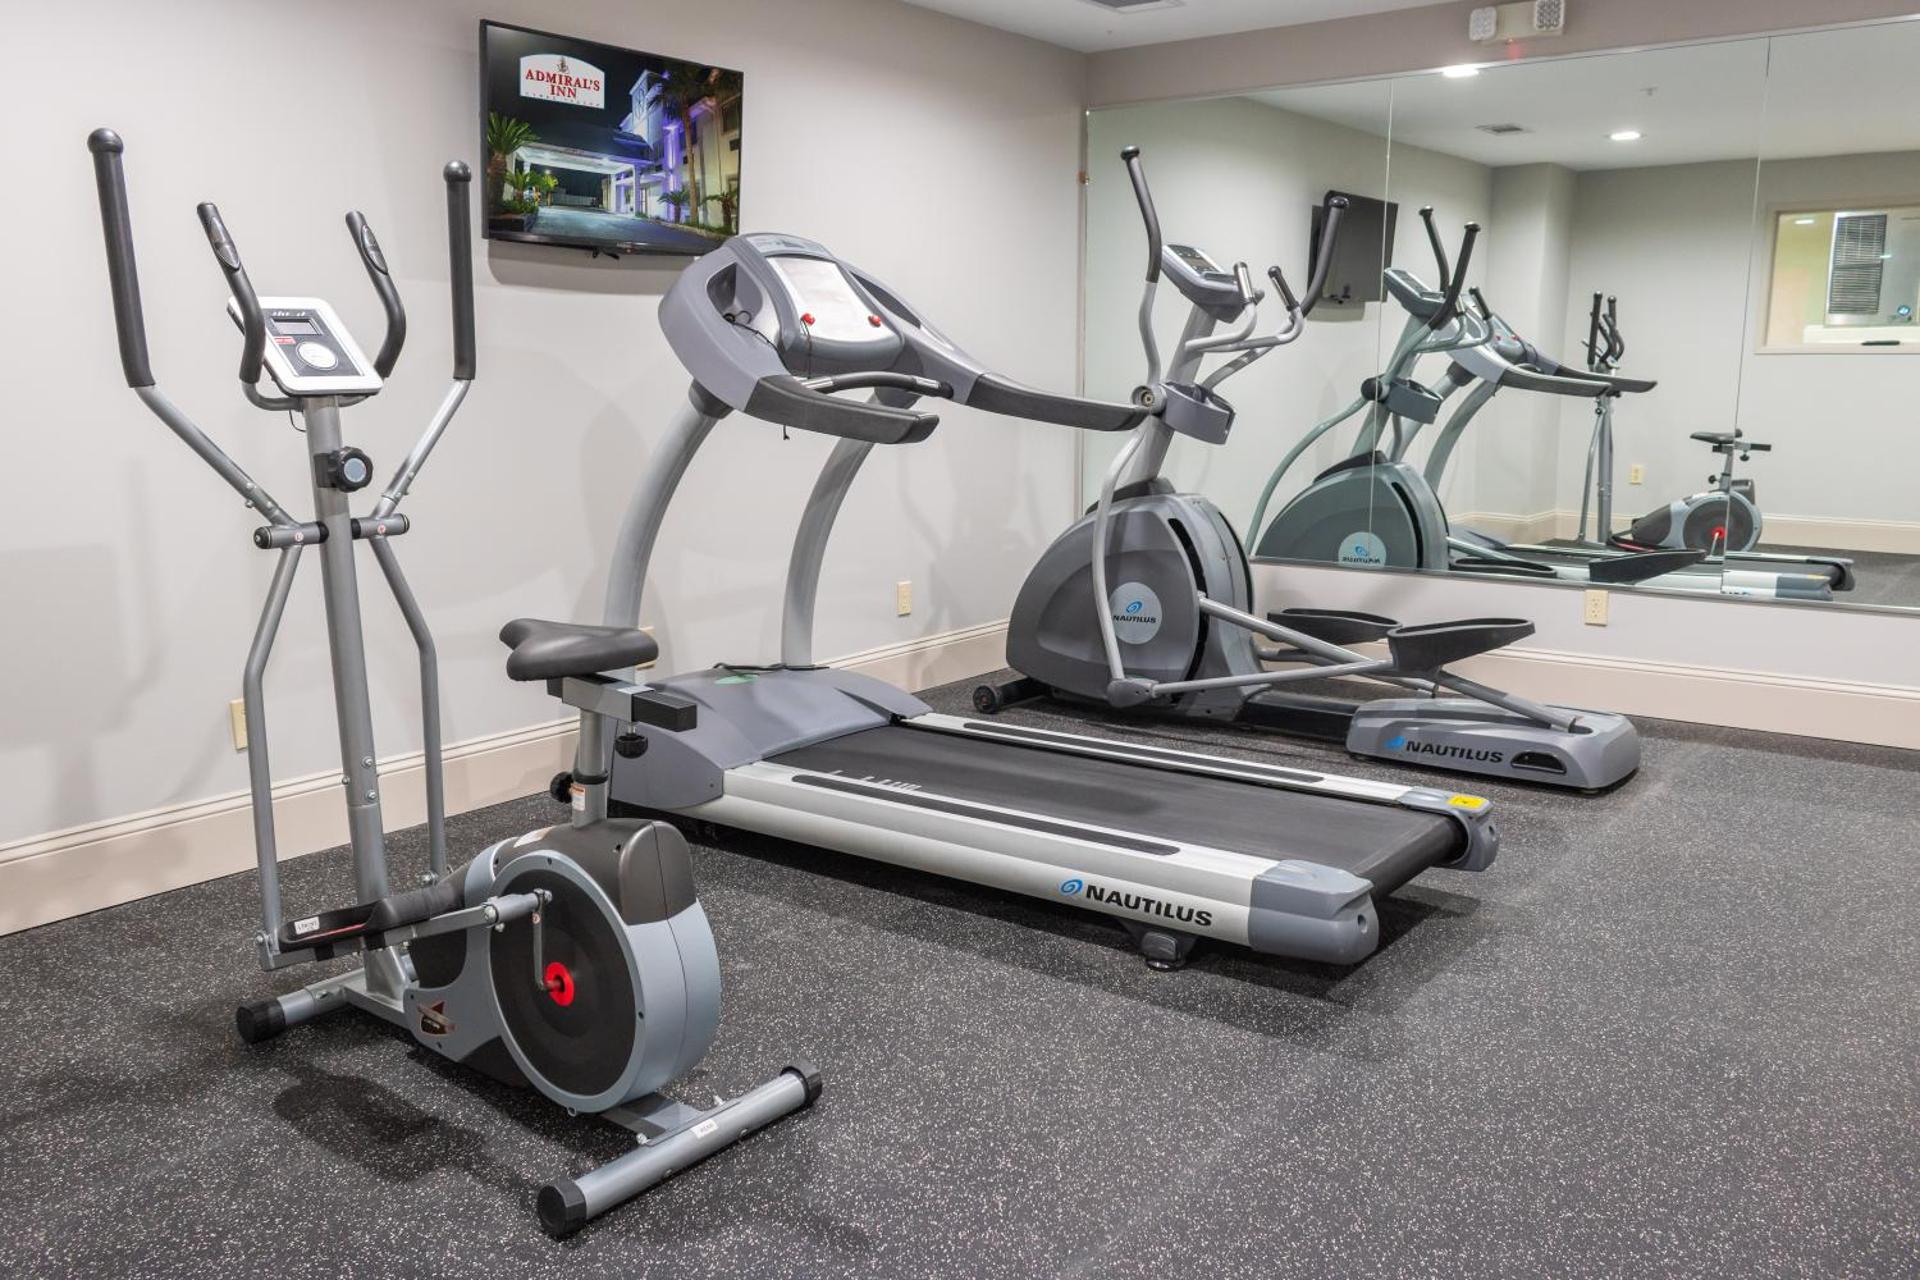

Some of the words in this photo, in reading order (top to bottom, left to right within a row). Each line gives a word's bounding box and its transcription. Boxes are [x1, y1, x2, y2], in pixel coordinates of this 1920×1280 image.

[525, 69, 600, 91] ADMIRAL'S
[550, 84, 577, 98] INN
[1112, 615, 1157, 624] NAUTILUS
[1405, 741, 1504, 763] NAUTILUS
[1086, 884, 1213, 926] NAUTILUS
